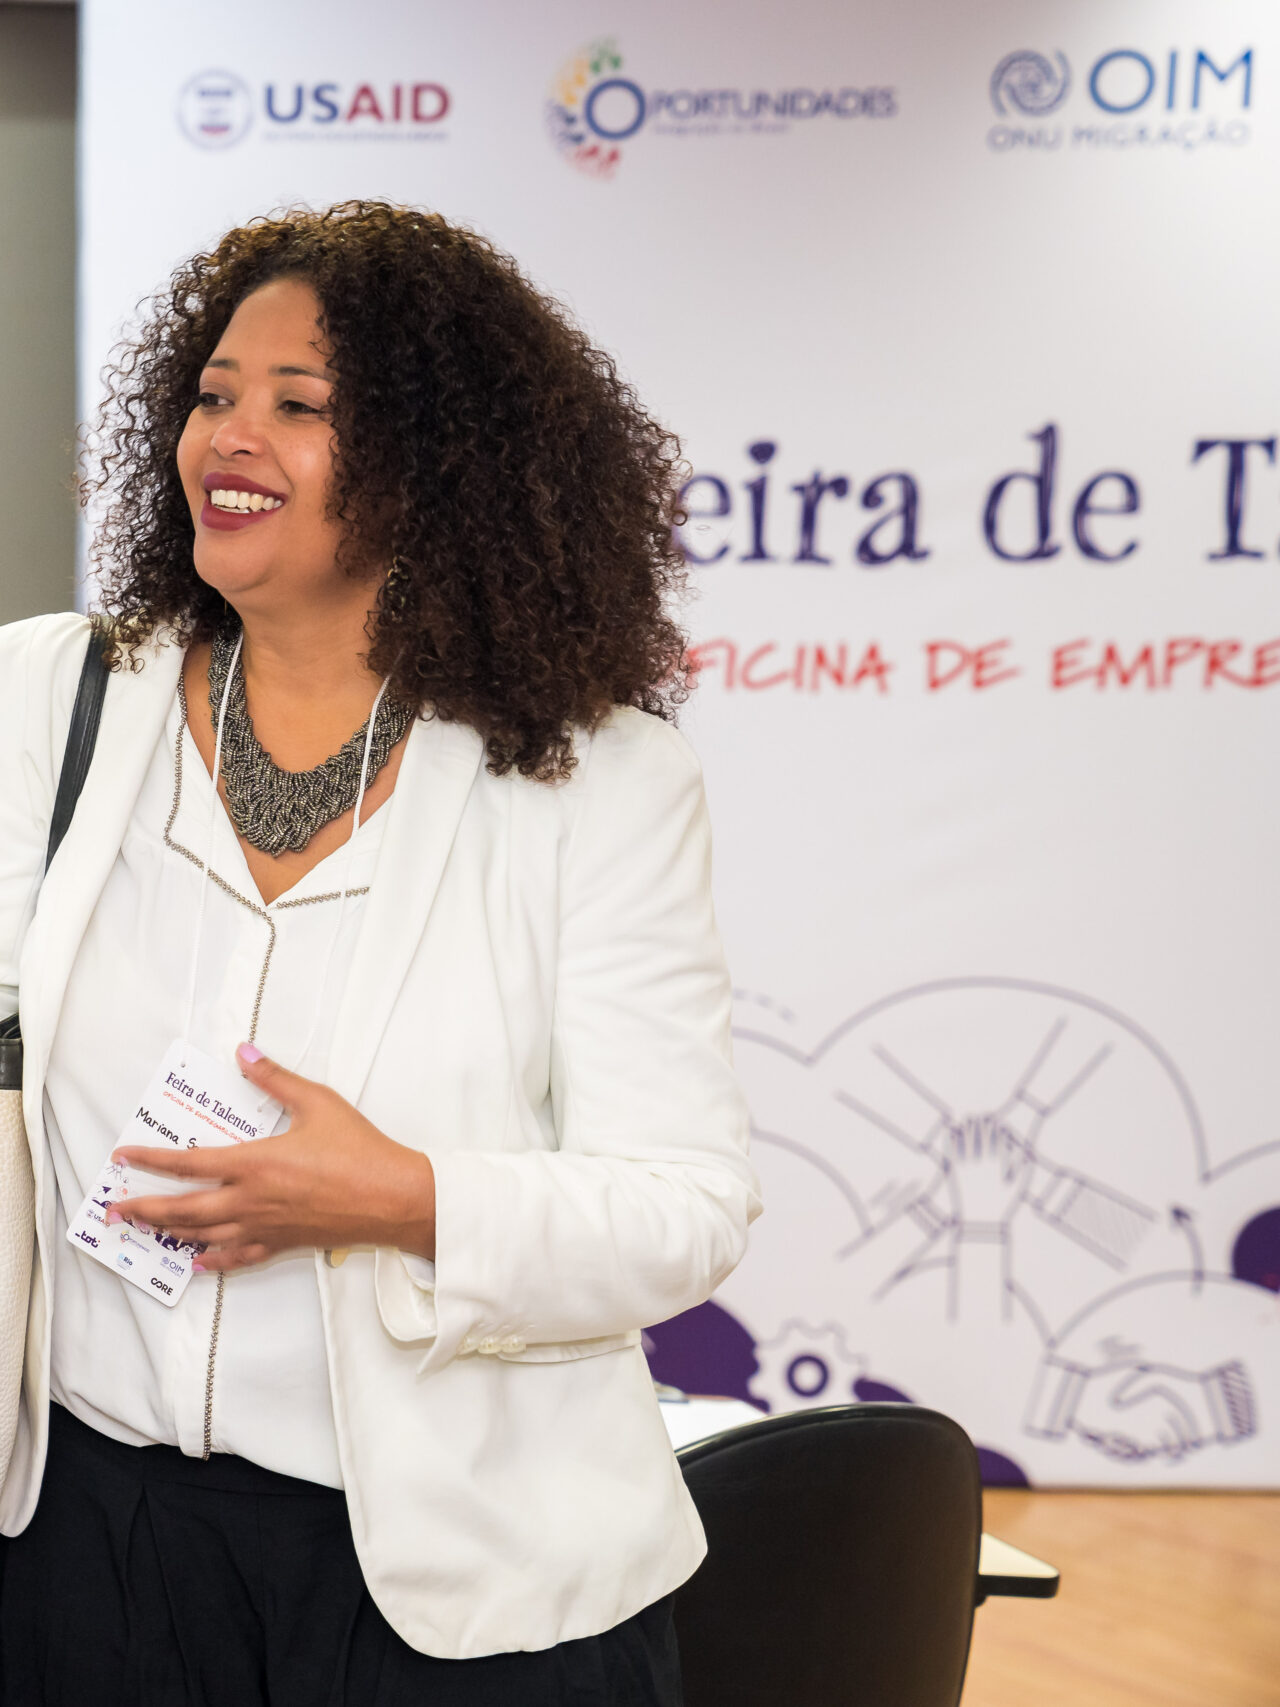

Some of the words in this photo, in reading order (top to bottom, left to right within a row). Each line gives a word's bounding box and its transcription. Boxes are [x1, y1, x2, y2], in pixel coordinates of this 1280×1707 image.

[1088, 49, 1253, 114] OIM
[263, 82, 451, 123] USAID
[585, 77, 899, 139] OPORTUNIDADES
[987, 124, 1063, 151] ONU
[671, 441, 931, 567] eira
[980, 422, 1142, 565] de
[1190, 436, 1280, 565] T
[682, 637, 892, 693] FICINA
[924, 637, 1020, 693] DE
[164, 1071, 195, 1098] Feira
[195, 1091, 211, 1108] de
[211, 1099, 258, 1138] Talentos
[135, 1106, 179, 1145] Mariana
[123, 1256, 133, 1266] Rio
[169, 1261, 185, 1276] OIM
[150, 1277, 174, 1296] CORE
